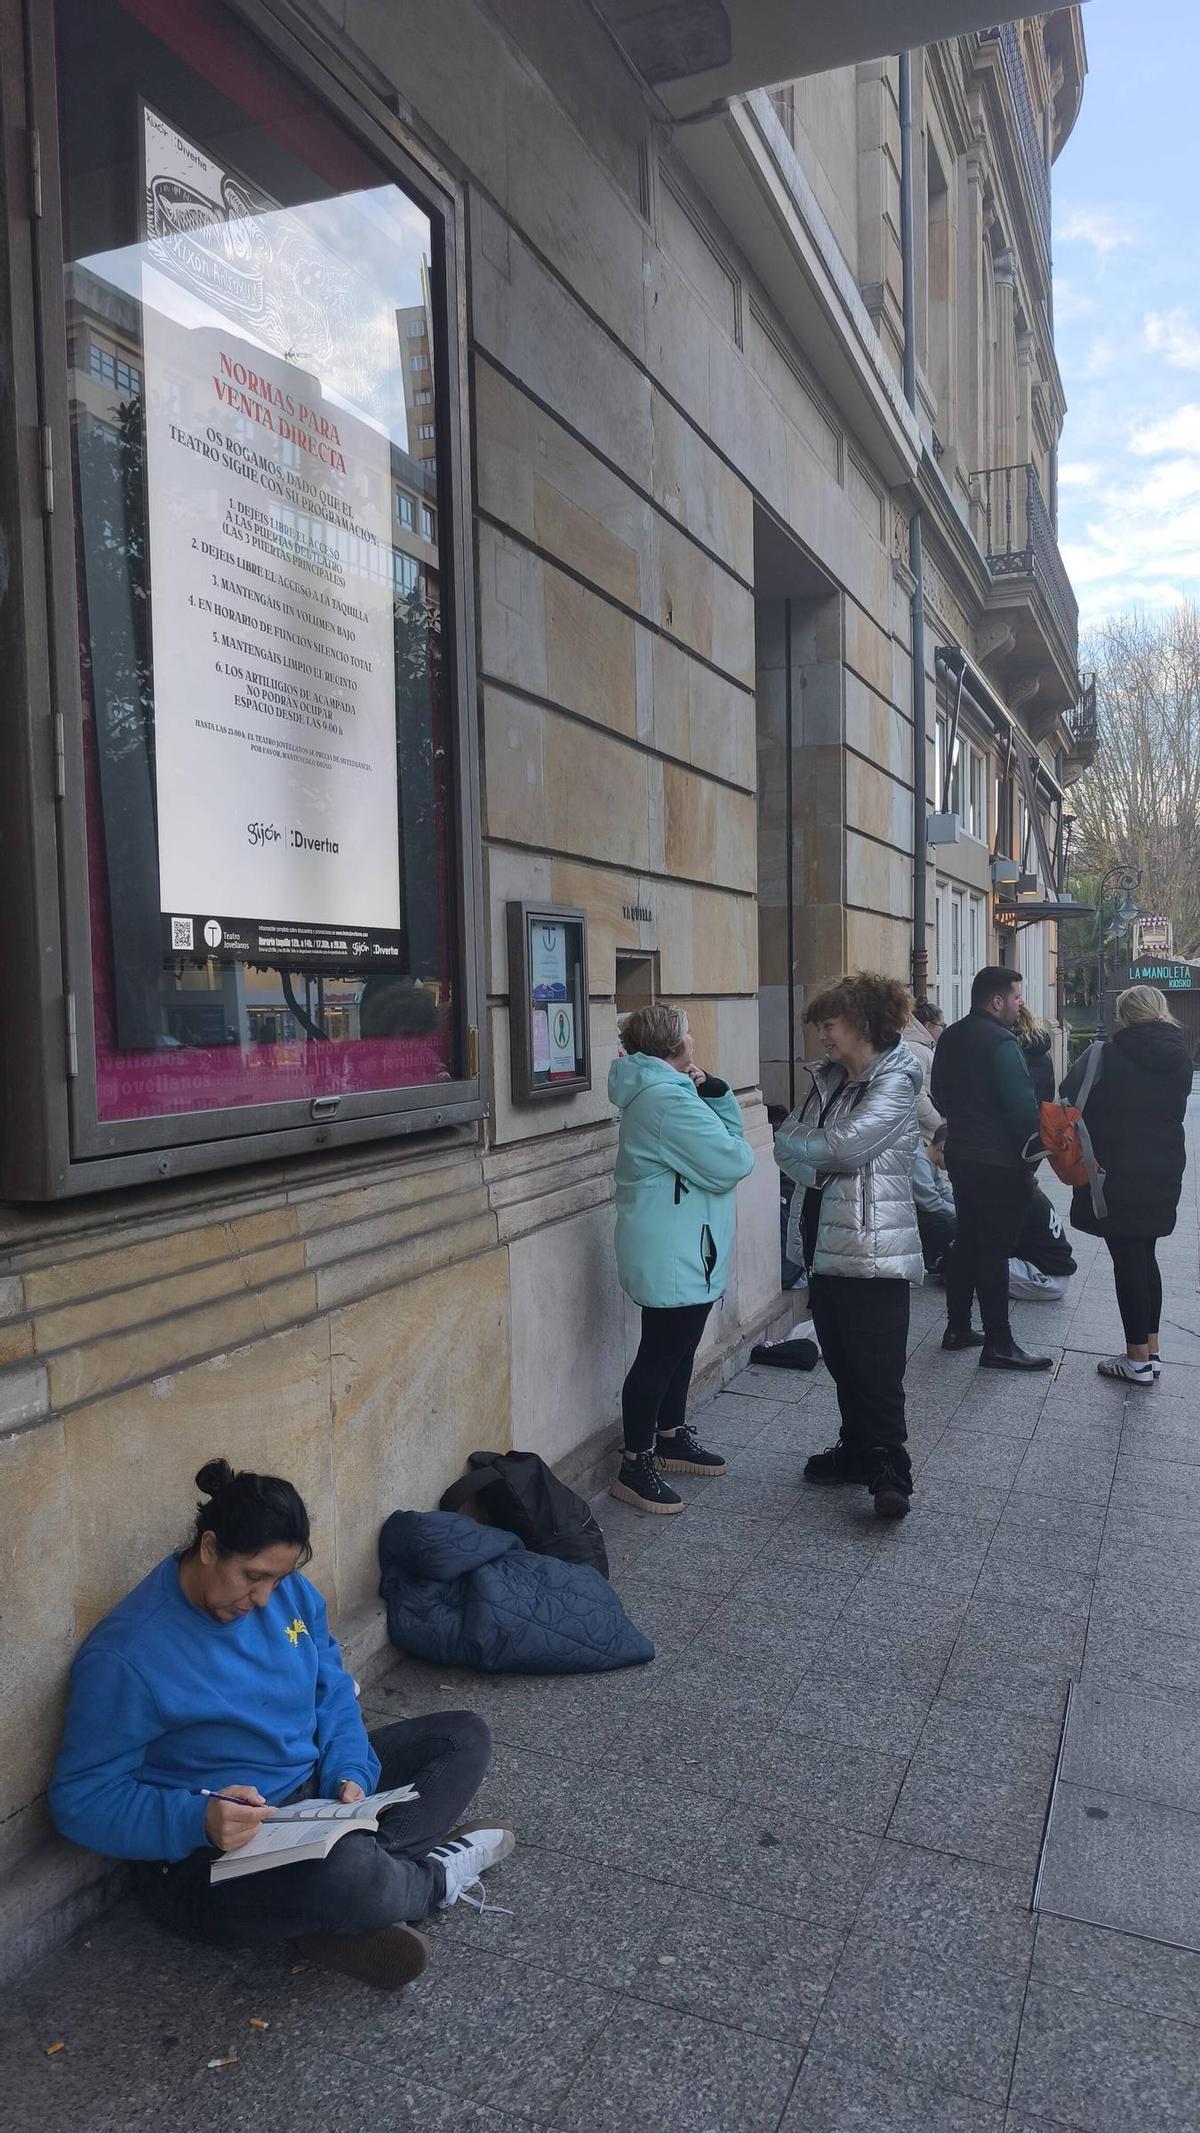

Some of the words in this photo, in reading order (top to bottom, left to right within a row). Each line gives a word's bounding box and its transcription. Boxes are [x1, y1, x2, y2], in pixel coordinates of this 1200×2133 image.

[212, 376, 274, 432] VENTA
[278, 415, 346, 473] DIRECTA
[219, 352, 294, 417] NORMAS
[298, 402, 340, 446] PARA
[169, 424, 219, 463] TEATRO
[222, 453, 258, 484] SIGUE
[260, 473, 283, 497] CON
[286, 487, 299, 505] SU
[206, 426, 222, 448] OS
[226, 437, 284, 482] ROGAMOS,
[286, 471, 317, 499] DADO
[319, 489, 340, 513] QUE
[342, 501, 354, 519] EL
[222, 522, 243, 542] (LAS
[244, 532, 250, 545] 3
[252, 536, 290, 563] PUERTAS
[225, 510, 232, 523] A
[235, 514, 252, 532] LAS
[254, 523, 292, 551] PUERTAS
[294, 543, 312, 560] DEL
[312, 551, 342, 575] TEATRO
[237, 501, 268, 527] DEJÉIS
[270, 518, 295, 539] LIBRE
[296, 531, 306, 545] EL
[308, 537, 339, 561] ACCESO
[191, 537, 199, 550] 2.
[201, 540, 235, 567] DEJÉIS
[237, 557, 263, 578] LIBRE
[265, 569, 275, 583] EL
[277, 575, 311, 599] ACCESO
[312, 590, 319, 602] A
[320, 594, 330, 607] LA
[331, 598, 368, 624] TAQUILLA
[211, 574, 219, 587] 3.
[220, 577, 281, 612] MANTENGÁIS
[283, 603, 294, 617] UN
[296, 609, 335, 634] VOLUMEN
[337, 625, 356, 642] BAJO
[188, 594, 196, 607] 4.
[198, 598, 212, 613] EN
[214, 604, 258, 630] HORARIO
[260, 622, 272, 635] DE
[313, 642, 349, 664] SILENCIO
[350, 656, 373, 673] TOTAL
[212, 631, 219, 643] 5.
[221, 633, 281, 665] MANTENGÁIS
[283, 656, 311, 675] LIMPIO
[313, 667, 321, 678] EL
[325, 671, 357, 691] RECINTO
[215, 660, 223, 673] 6.
[225, 664, 243, 679] LOS
[245, 670, 298, 697] ARTILUGIOS
[299, 688, 311, 701] DE
[313, 693, 356, 715] ACAMPADA
[234, 695, 274, 716] ESPACIO
[276, 707, 304, 724] DESDE
[306, 716, 321, 729] LAS
[246, 685, 260, 698] NO
[262, 688, 298, 709] PODRÁN
[299, 701, 333, 720] OCUPAR
[247, 822, 282, 847] gijón
[223, 931, 241, 941] Teatro
[223, 940, 250, 951] Jovellanos
[1129, 967, 1141, 980] LA
[1168, 979, 1192, 988] KIOSKO
